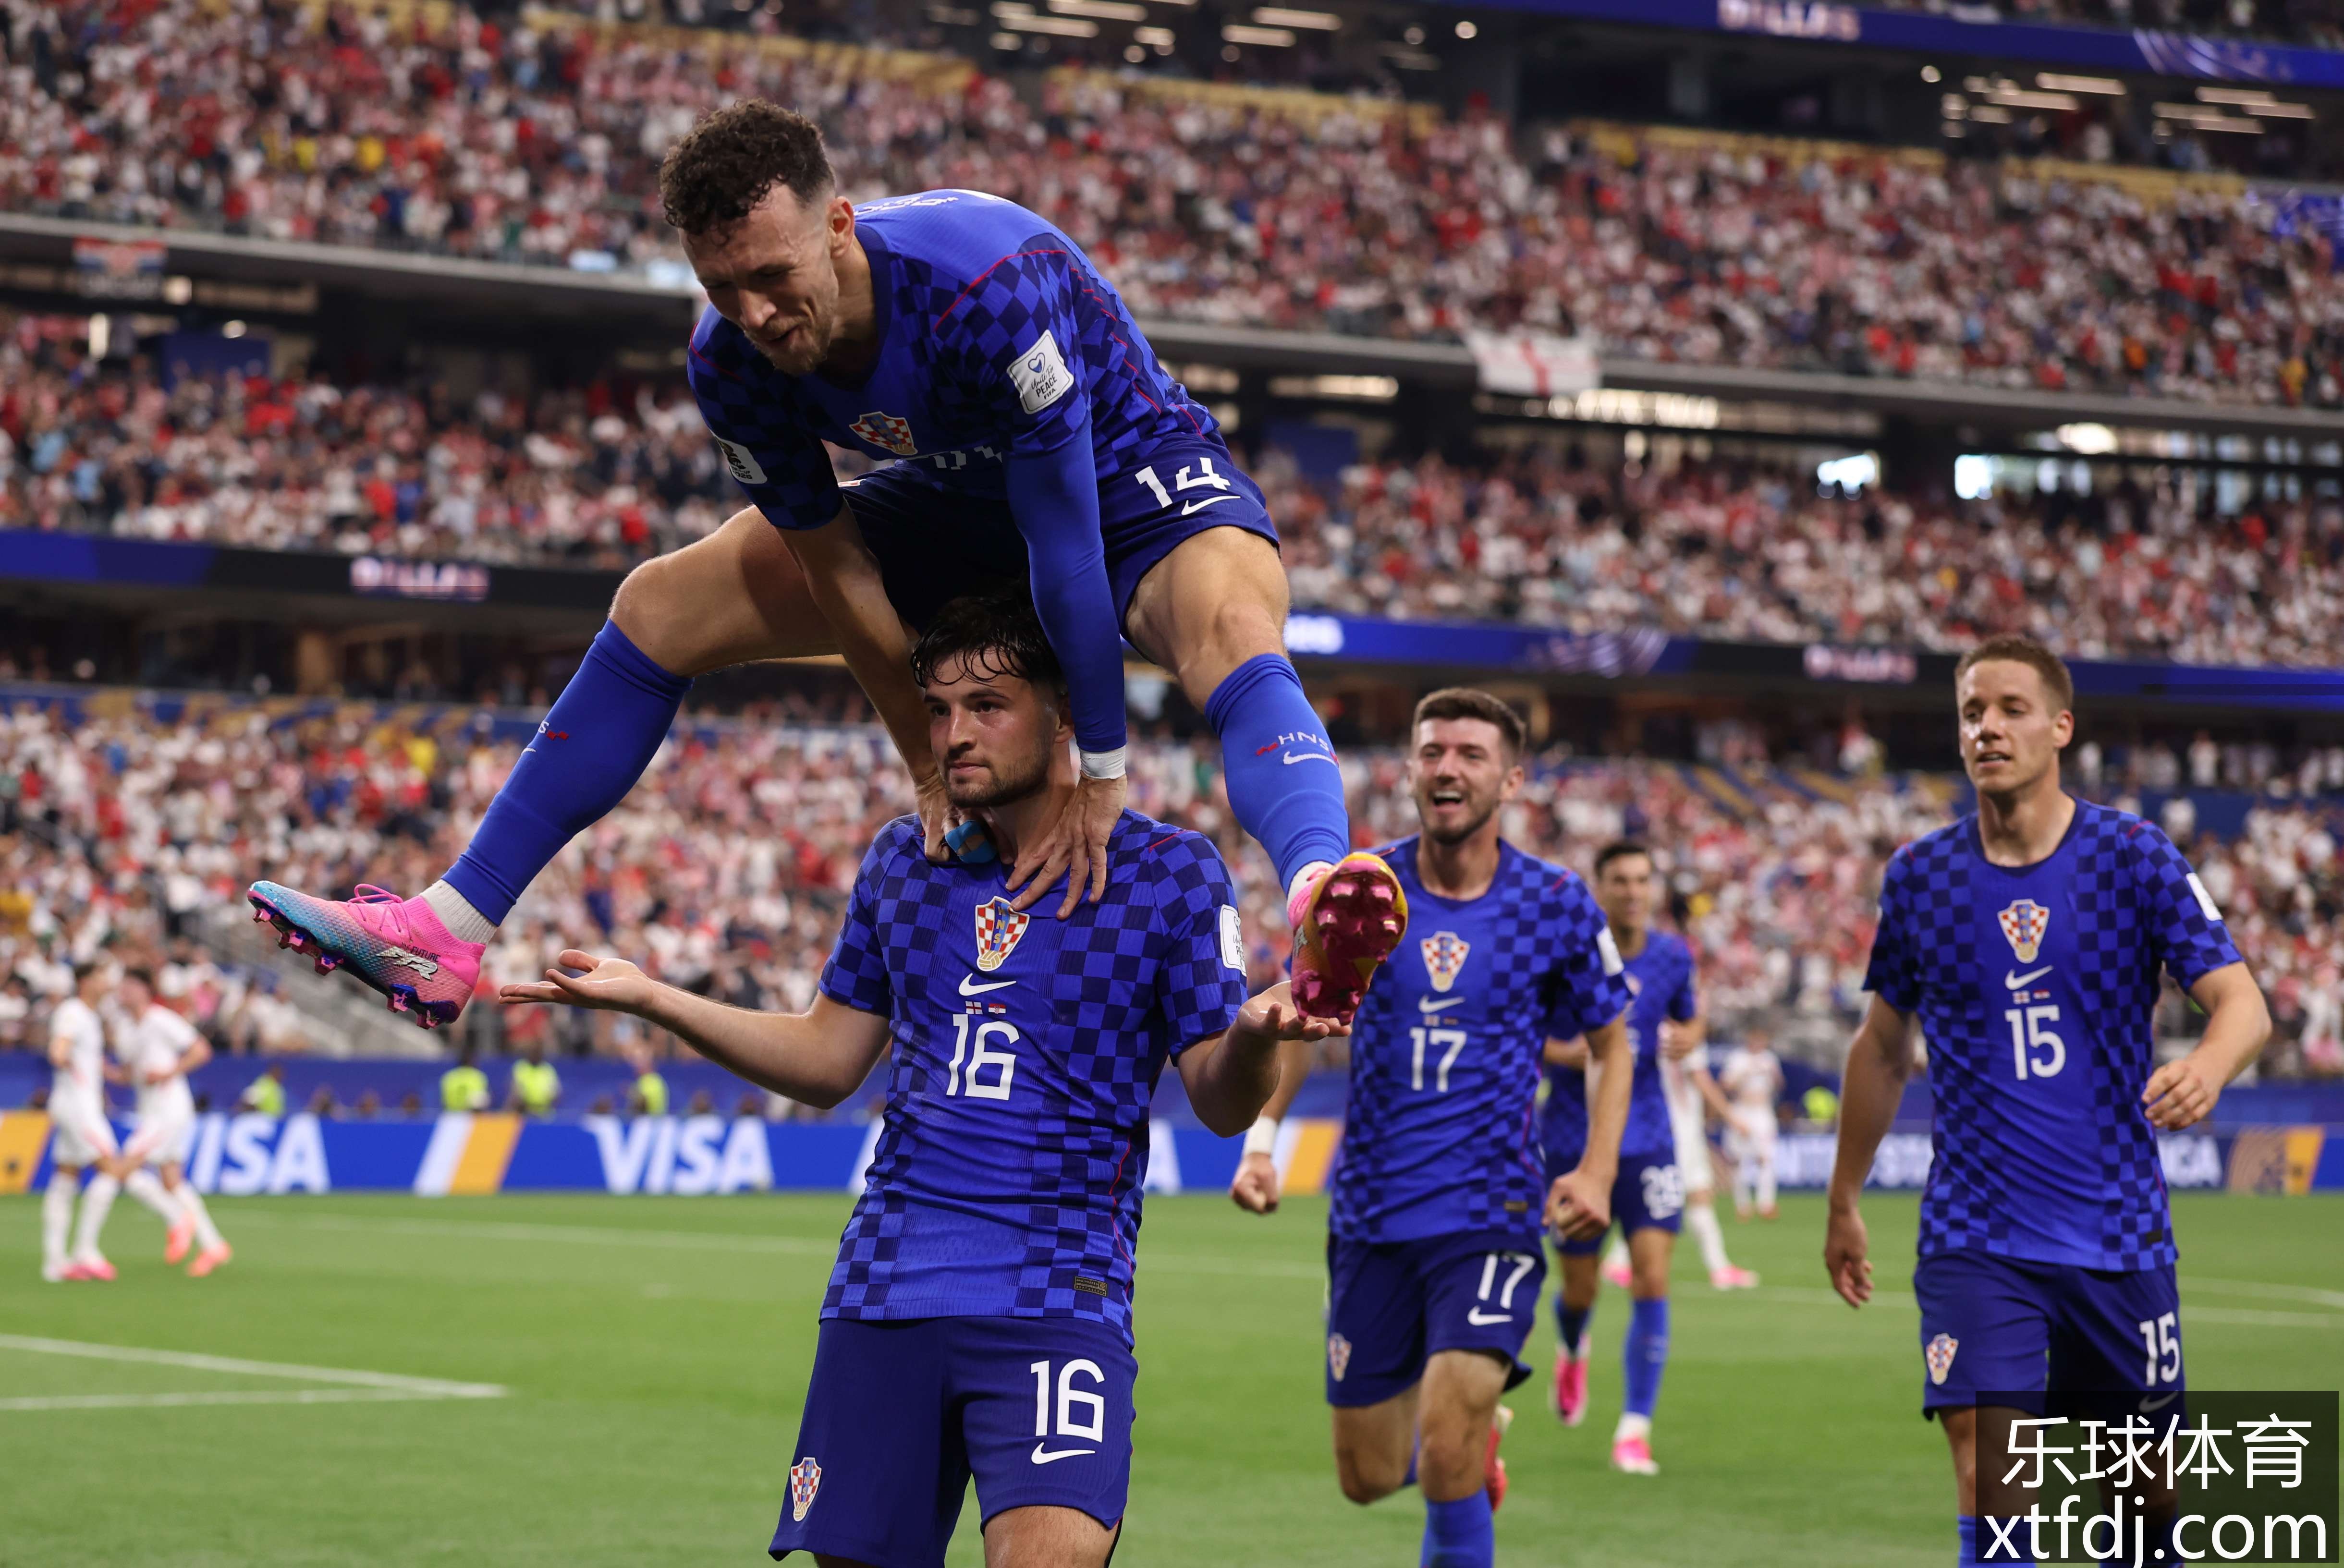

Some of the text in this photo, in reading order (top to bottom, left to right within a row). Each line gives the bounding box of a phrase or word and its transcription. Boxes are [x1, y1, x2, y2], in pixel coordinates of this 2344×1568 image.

[1035, 373, 1058, 397] PEACE
[1043, 388, 1056, 400] FIFA
[1135, 457, 1231, 509] 14
[1278, 731, 1329, 752] HNS
[411, 946, 441, 962] FUTURE
[945, 1013, 1020, 1101] 16
[1409, 1026, 1467, 1093] 17
[2004, 1004, 2066, 1078] 15
[581, 1112, 776, 1196] VISA
[1477, 1252, 1536, 1310] 17
[2138, 1311, 2181, 1387] 15
[1031, 1359, 1105, 1443] 16
